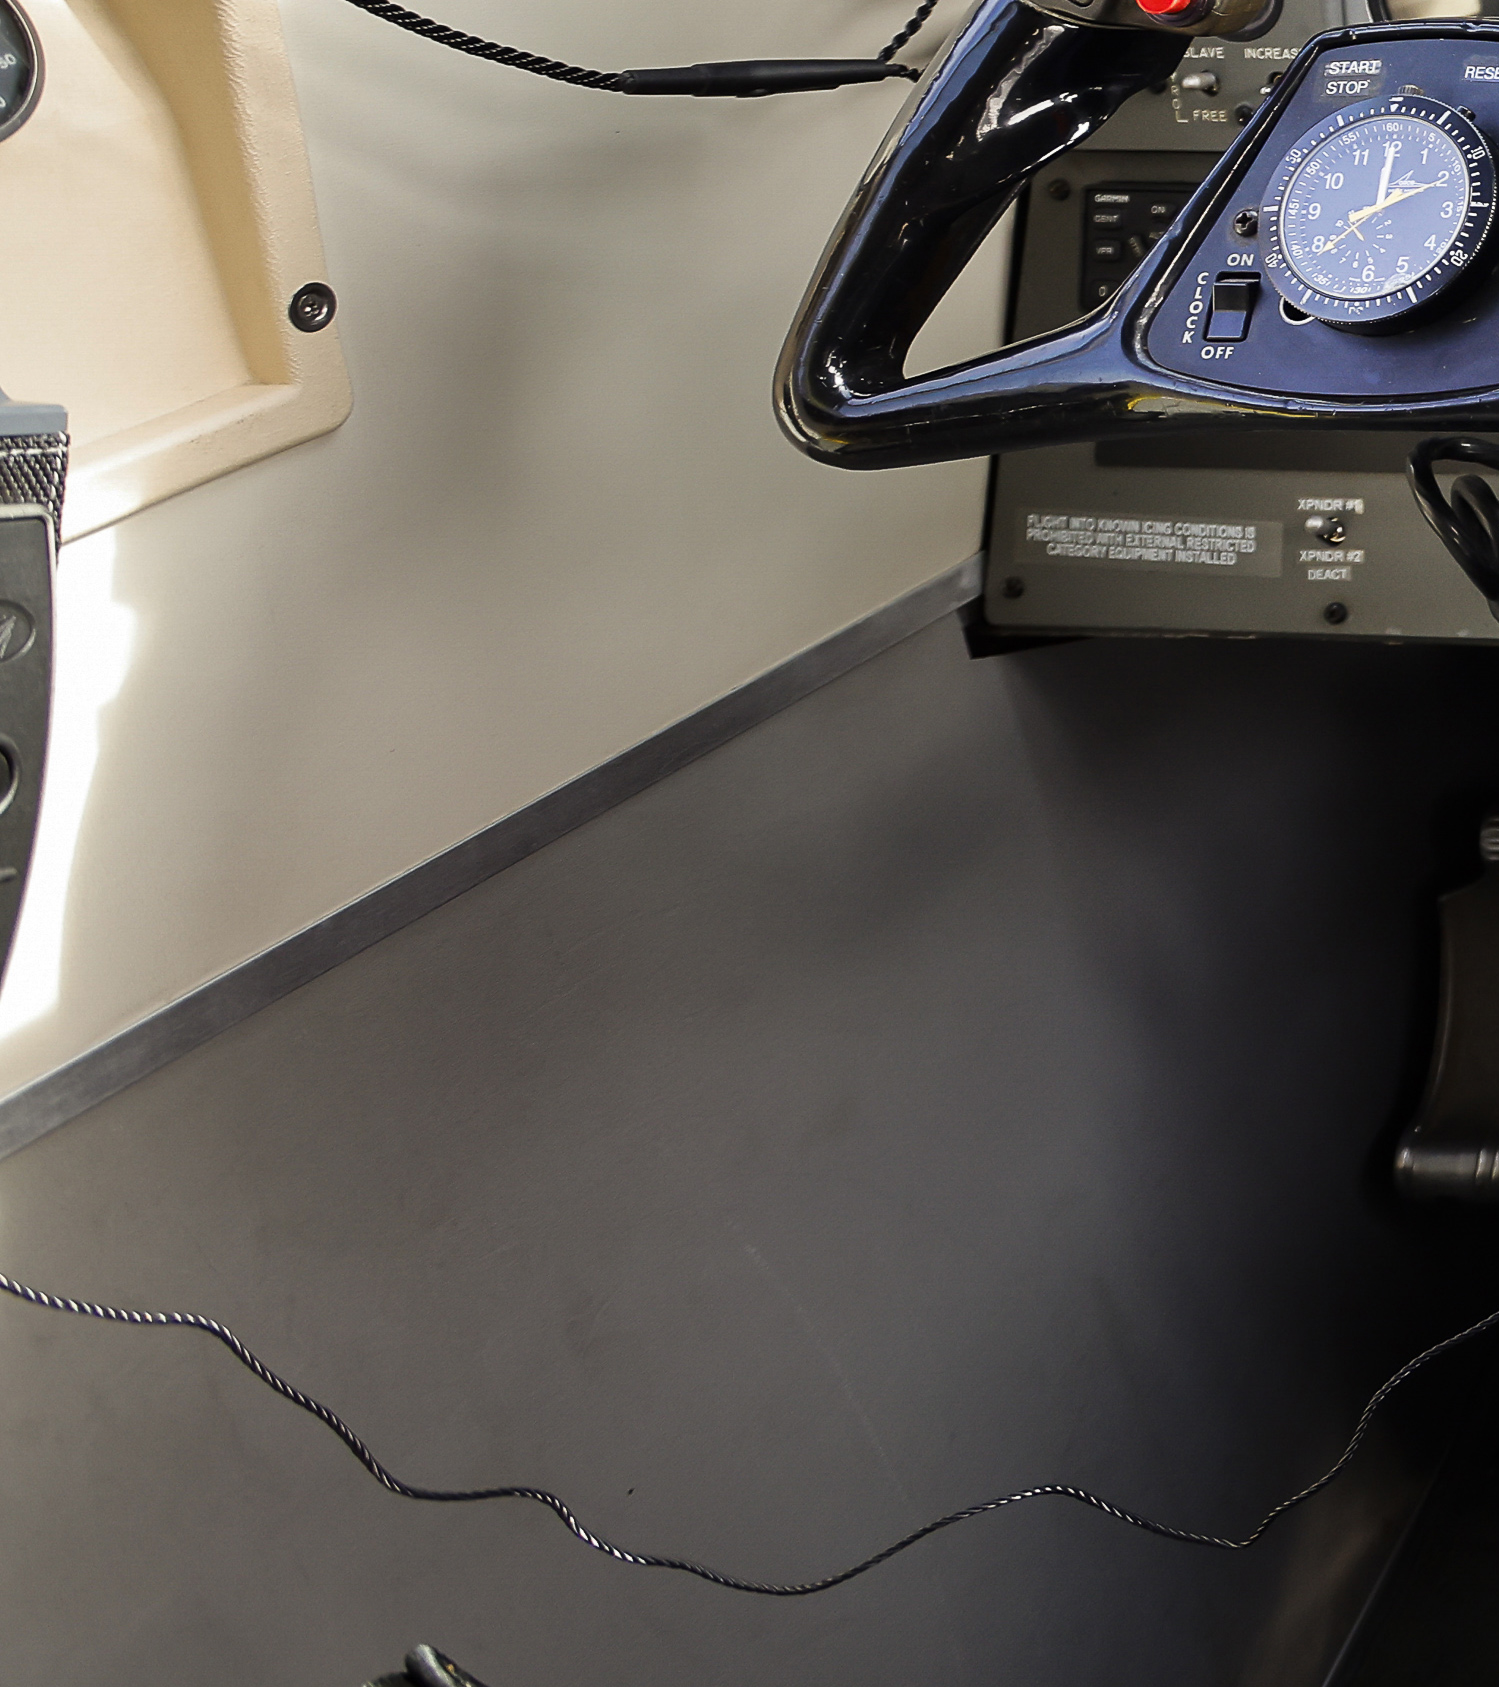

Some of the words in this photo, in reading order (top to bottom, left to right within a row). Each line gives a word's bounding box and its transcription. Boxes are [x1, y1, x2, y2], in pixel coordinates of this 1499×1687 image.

[1328, 60, 1380, 75] START
[1326, 80, 1370, 95] STOP
[1227, 254, 1254, 267] ON
[1201, 346, 1234, 360] OFF
